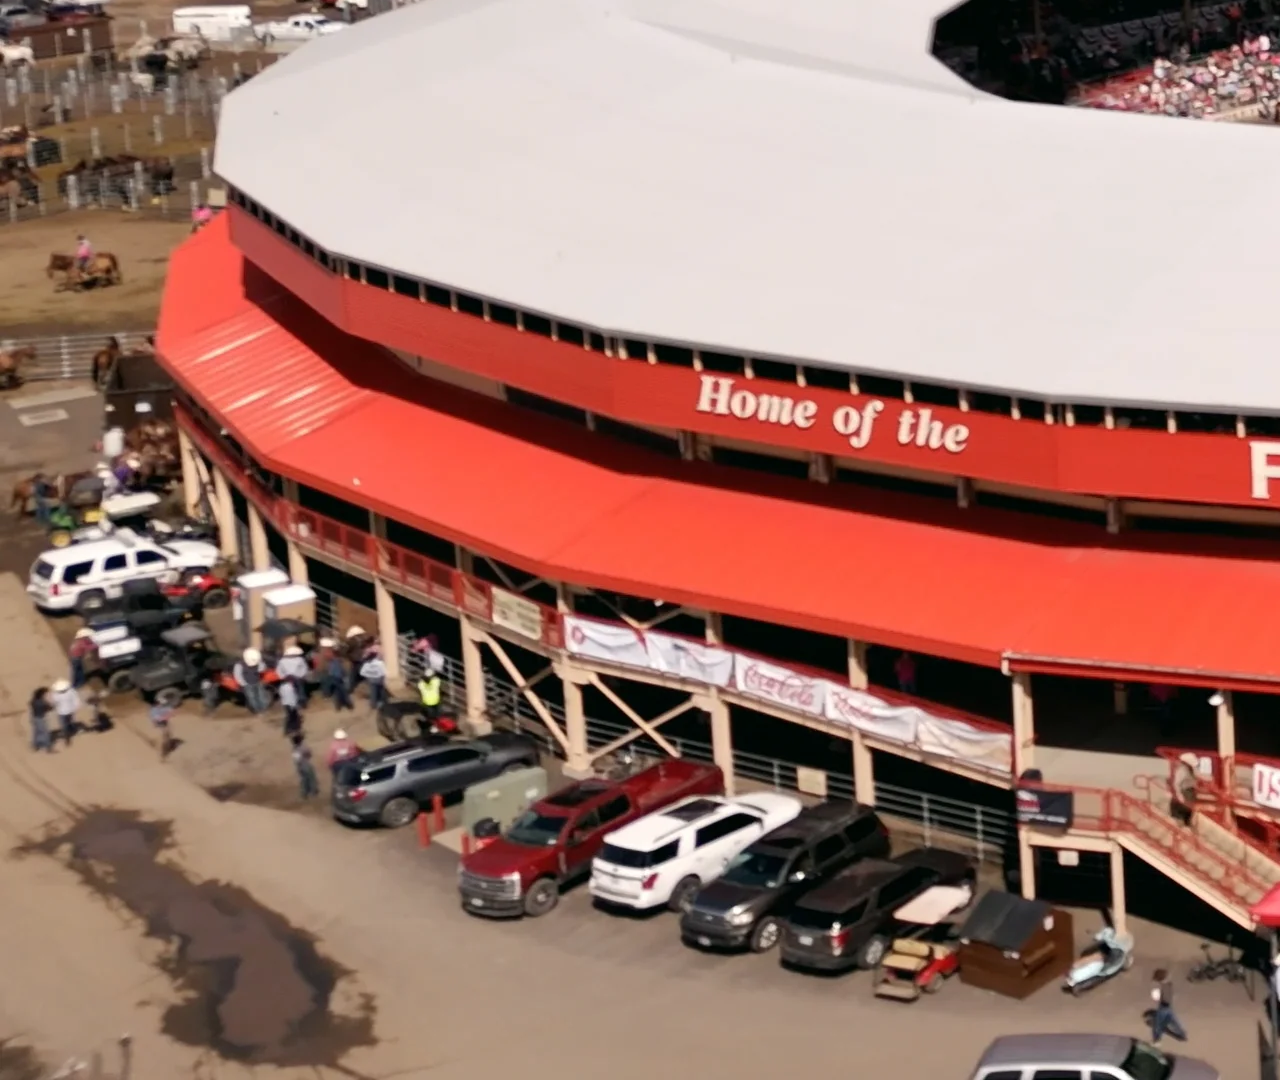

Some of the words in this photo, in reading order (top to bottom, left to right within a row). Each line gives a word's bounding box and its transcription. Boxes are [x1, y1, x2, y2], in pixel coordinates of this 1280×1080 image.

[695, 374, 818, 429] Home
[832, 399, 885, 449] of
[897, 408, 970, 453] the
